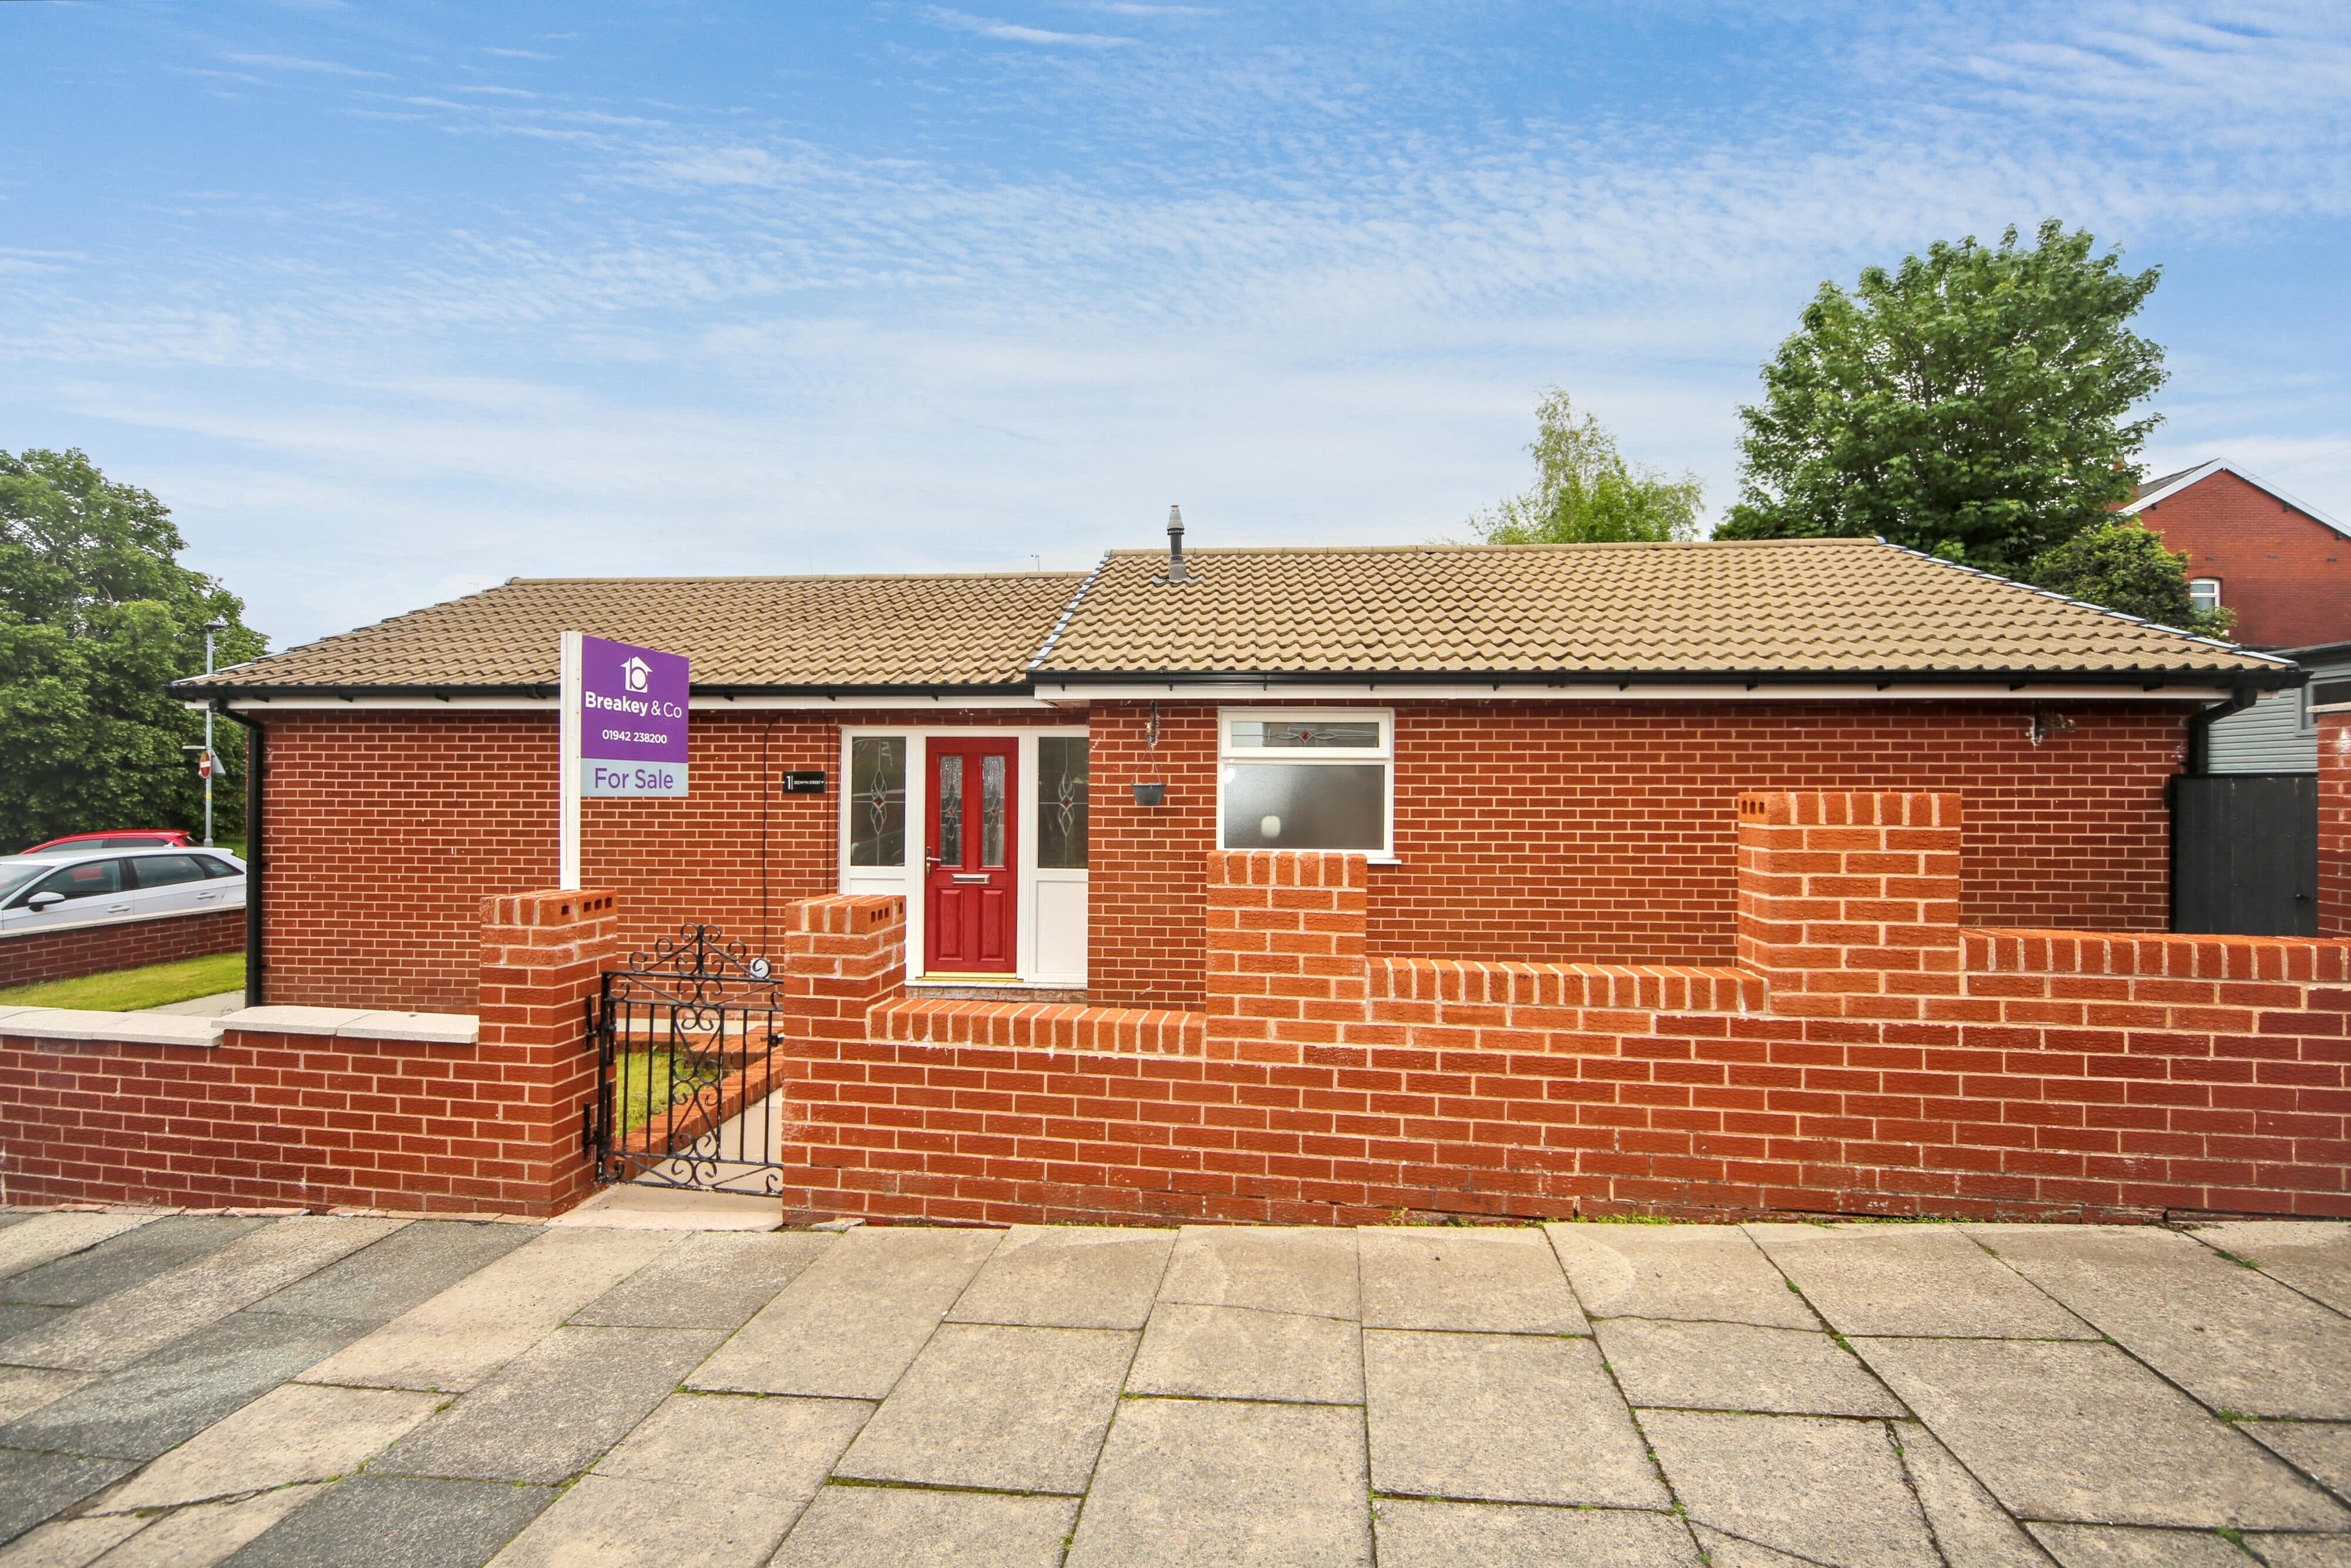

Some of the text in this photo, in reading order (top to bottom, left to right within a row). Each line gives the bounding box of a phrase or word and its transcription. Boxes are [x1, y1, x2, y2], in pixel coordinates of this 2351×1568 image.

[585, 691, 682, 718] Breakey & Co
[602, 729, 667, 744] 01942 238200
[595, 768, 674, 789] For Sale
